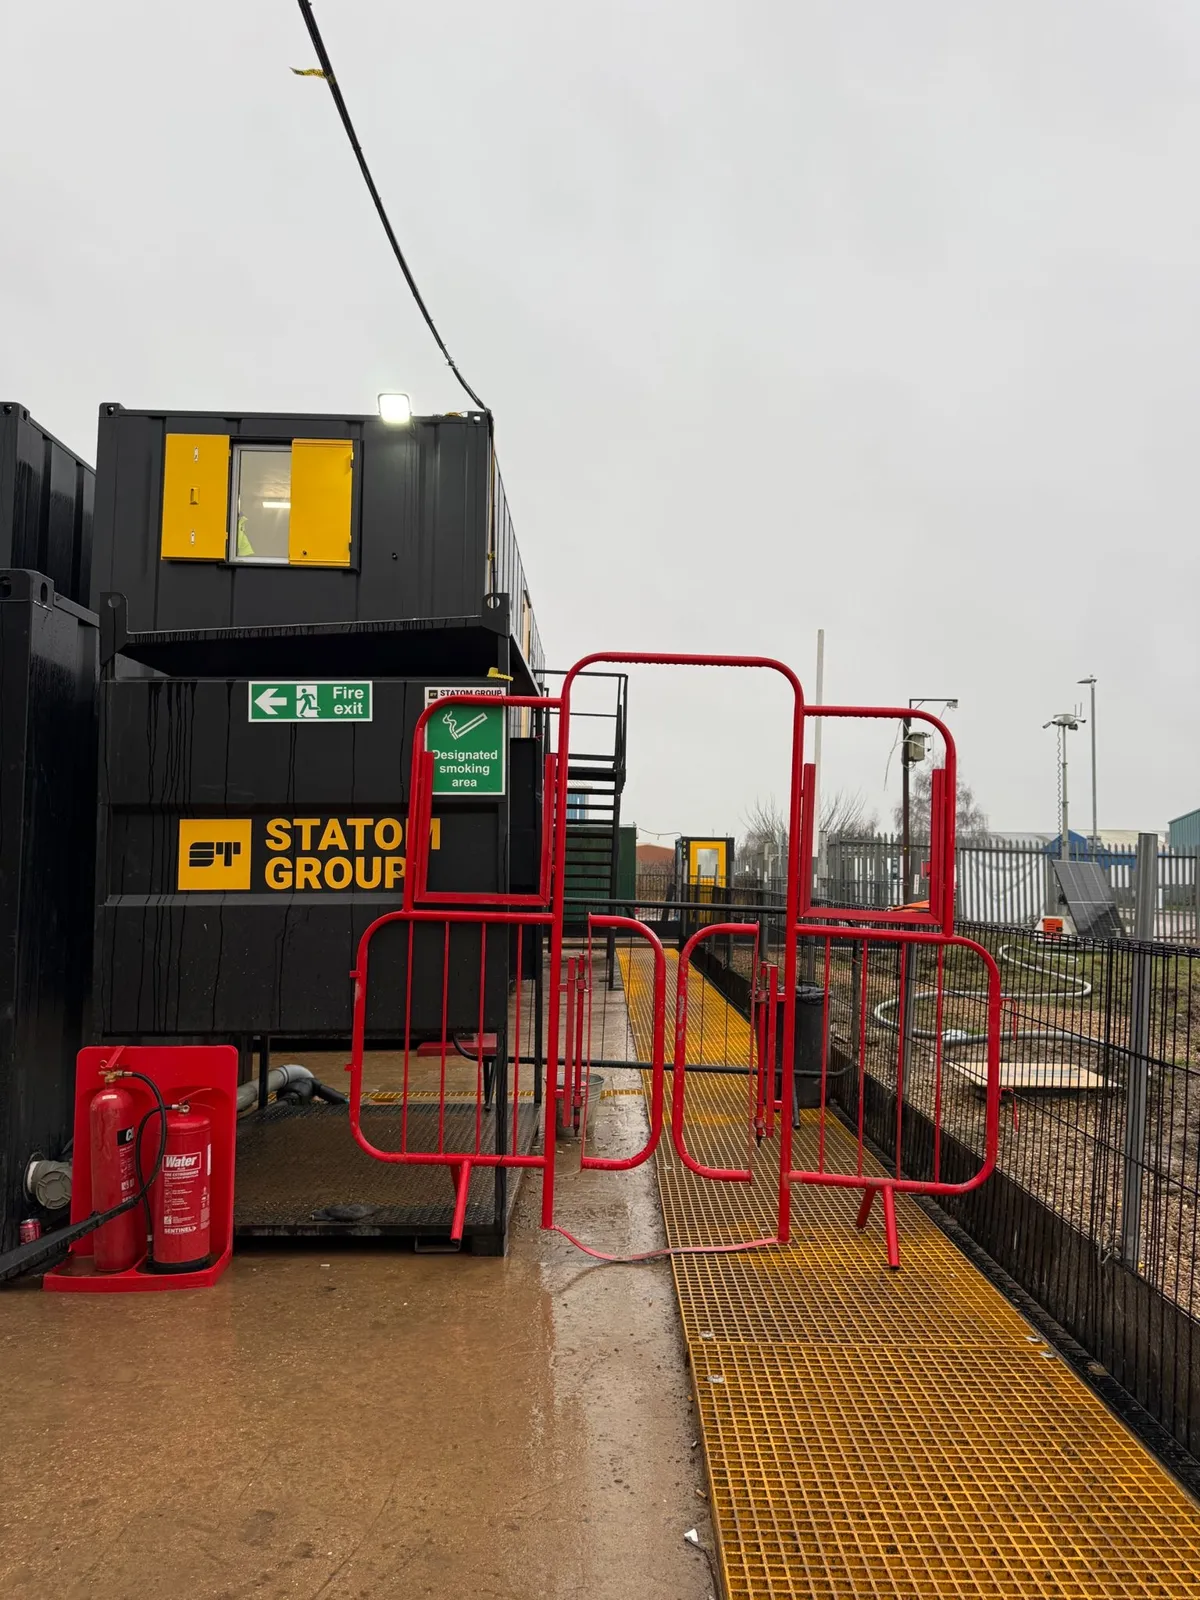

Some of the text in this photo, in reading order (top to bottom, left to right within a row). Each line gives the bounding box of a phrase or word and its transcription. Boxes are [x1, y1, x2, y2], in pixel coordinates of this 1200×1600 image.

[332, 686, 365, 699] Fire
[333, 702, 363, 715] exit
[432, 749, 498, 762] Designated
[439, 763, 490, 776] smoking
[452, 778, 478, 788] area
[264, 856, 407, 889] GROUP
[166, 1156, 197, 1168] Water
